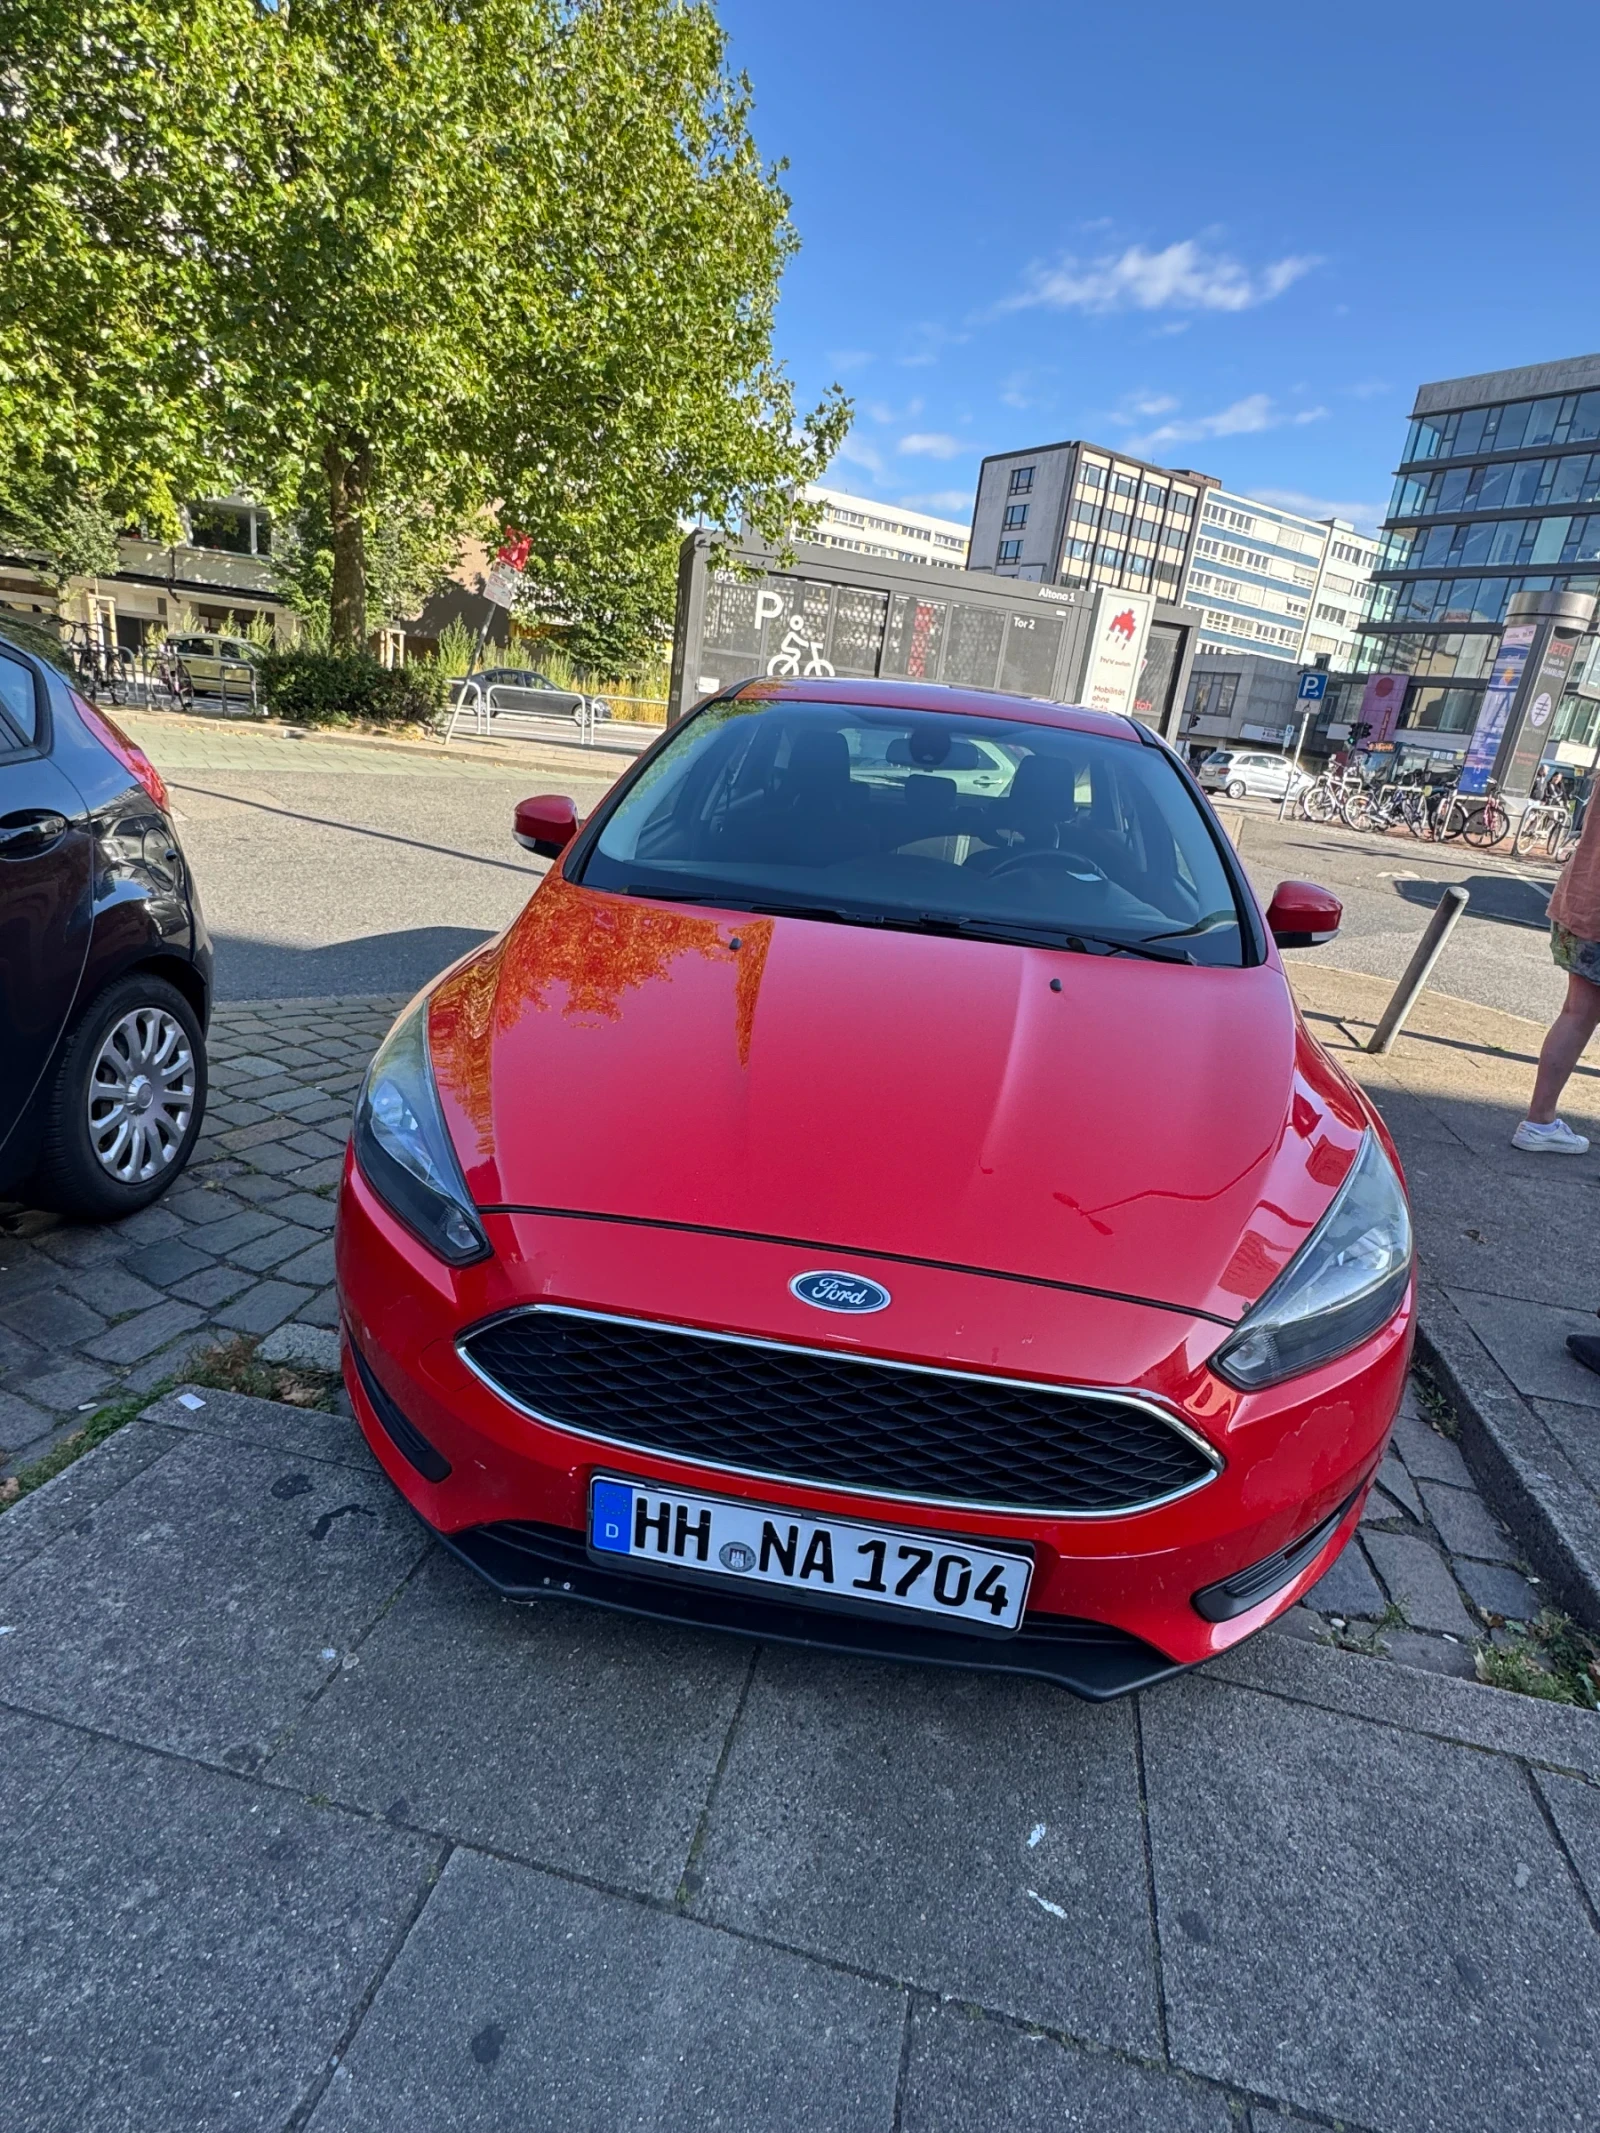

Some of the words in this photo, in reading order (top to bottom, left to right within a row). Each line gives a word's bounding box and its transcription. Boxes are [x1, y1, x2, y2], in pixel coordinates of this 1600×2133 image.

[1038, 586, 1068, 601] Altona
[1069, 592, 1076, 602] 1
[754, 589, 784, 630] P
[1014, 616, 1028, 628] Tor
[1028, 619, 1035, 630] 2
[1093, 684, 1126, 697] Mobilität
[1302, 676, 1319, 697] P
[1091, 695, 1110, 704] ohne
[811, 1277, 868, 1305] Ford
[605, 1523, 619, 1538] D
[634, 1497, 712, 1562] HH
[758, 1520, 835, 1584] NA
[852, 1539, 1009, 1617] 1704
